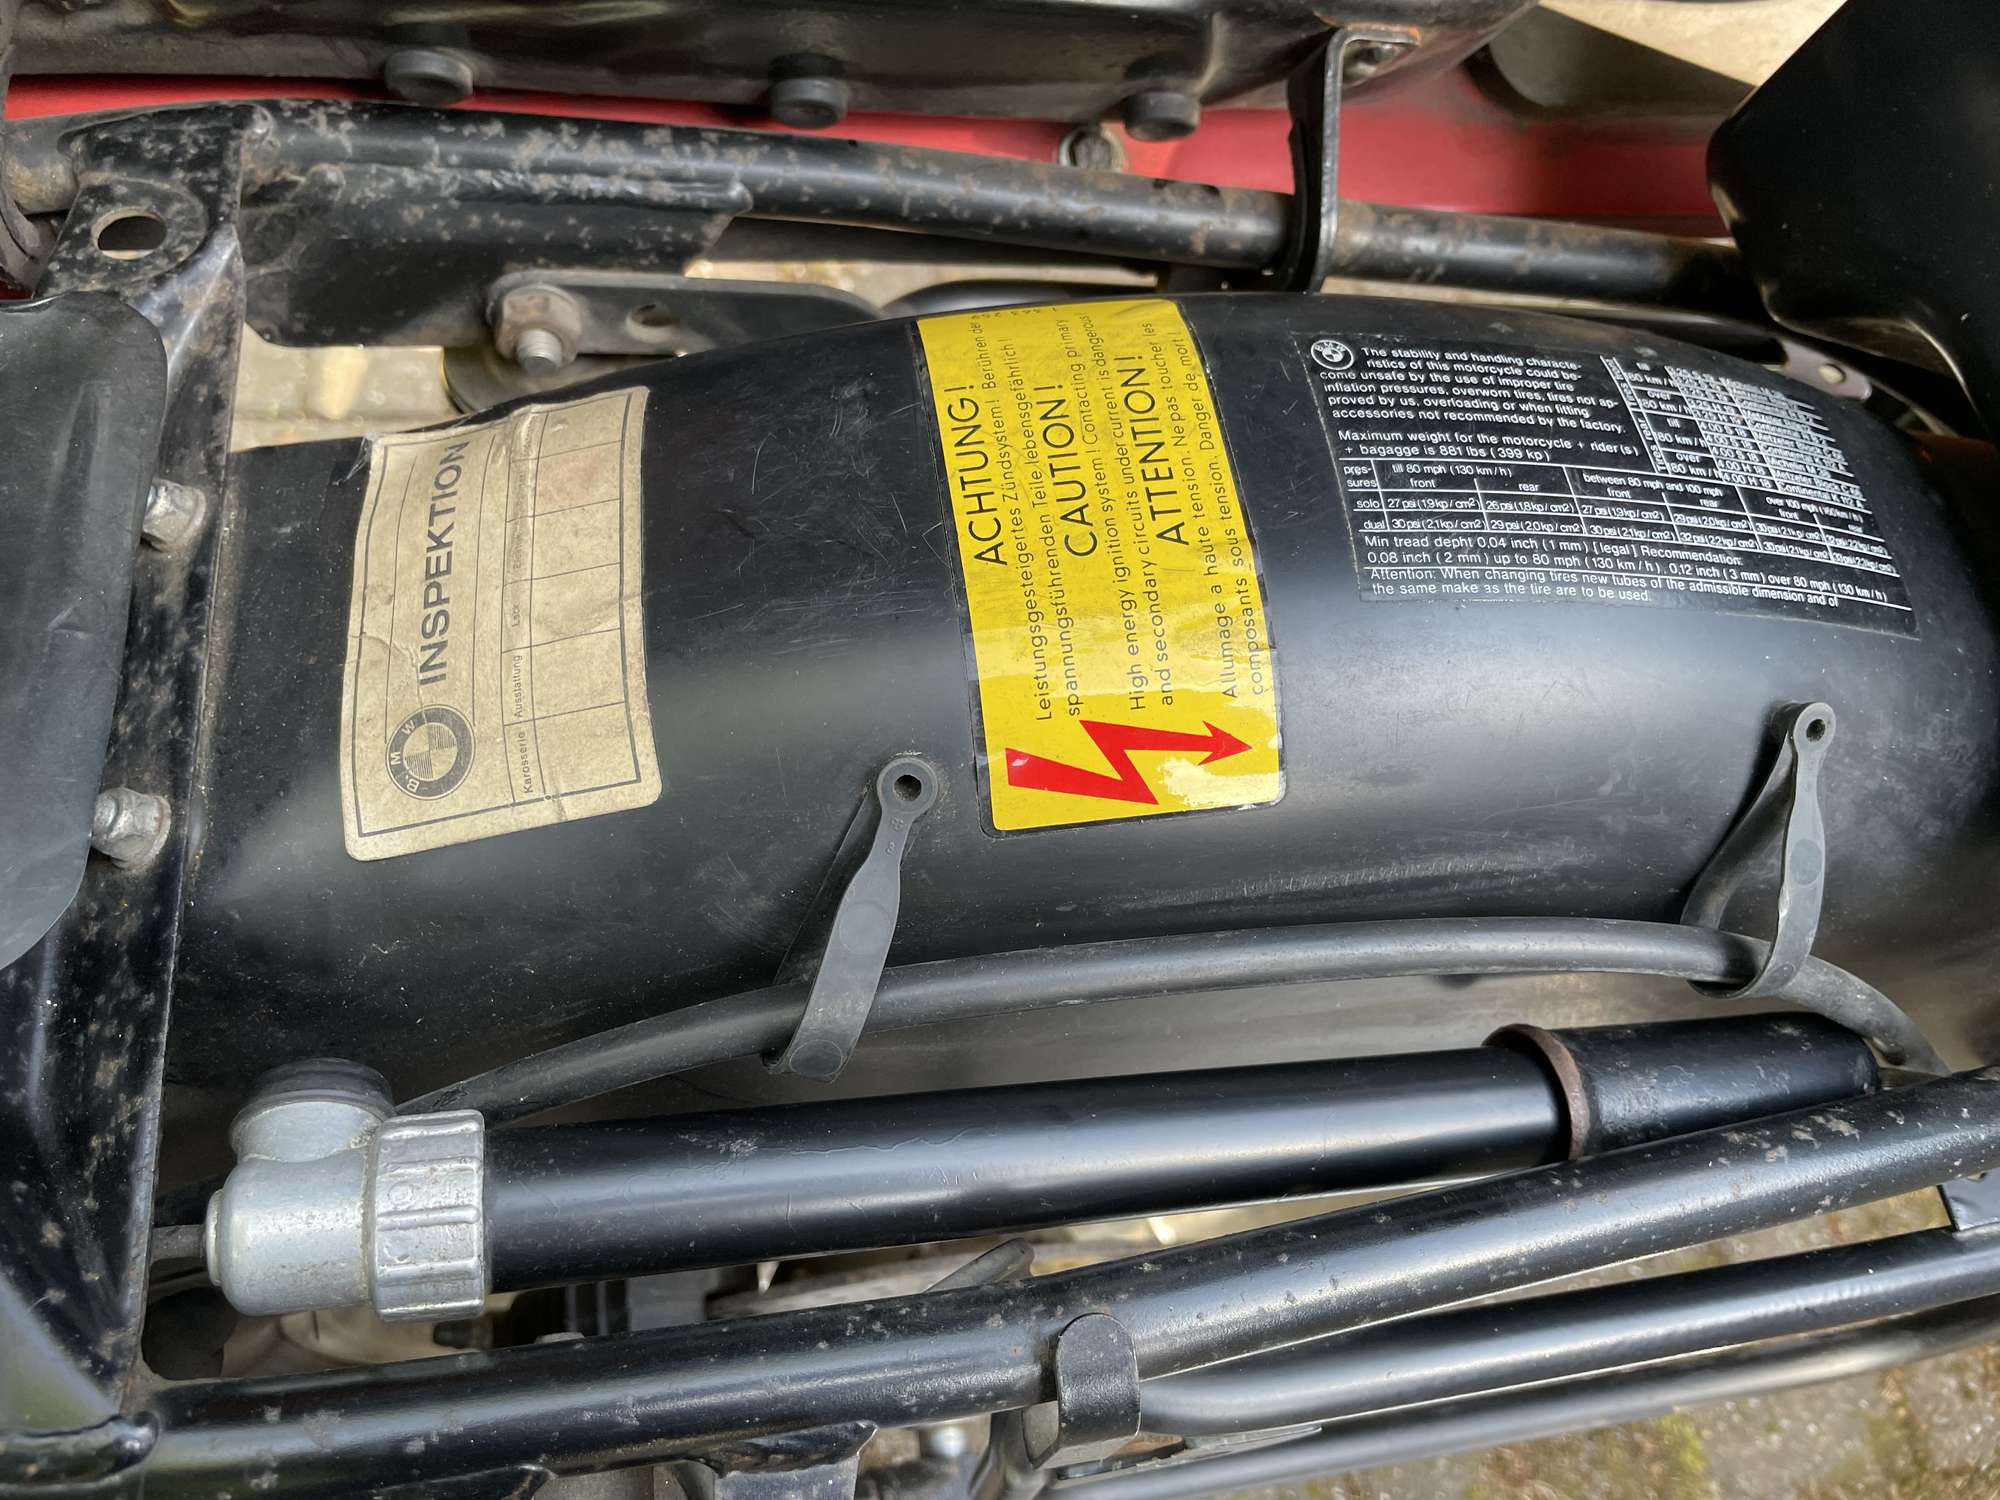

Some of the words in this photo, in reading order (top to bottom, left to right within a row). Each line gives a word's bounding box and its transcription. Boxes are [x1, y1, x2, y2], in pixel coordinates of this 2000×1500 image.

[968, 322, 981, 334] der
[1056, 319, 1079, 357] primary
[1141, 322, 1156, 336] les
[973, 336, 997, 388] Berühren
[1097, 370, 1110, 380] is
[1148, 341, 1170, 388] toucher
[1361, 347, 1387, 357] The
[1391, 348, 1439, 360] stability
[1444, 351, 1468, 361] and
[1470, 353, 1523, 366] handling
[1526, 358, 1582, 370] characte-
[1367, 359, 1406, 369] ristics
[1409, 360, 1422, 369] of
[1426, 361, 1450, 371] this
[1453, 363, 1522, 376] motorcycle
[1526, 369, 1559, 379] could
[1561, 370, 1582, 381] be-
[1183, 373, 1198, 390] de
[1320, 371, 1356, 380] come
[1360, 371, 1405, 381] unsafe
[1408, 372, 1425, 384] by
[1429, 373, 1451, 383] the
[1454, 375, 1479, 384] use
[1482, 375, 1495, 385] of
[1498, 376, 1552, 390] improper
[1554, 381, 1575, 391] tire
[1323, 382, 1376, 393] inflation
[1380, 383, 1449, 396] pressures,
[1452, 387, 1511, 398] overworn
[1513, 390, 1546, 401] tires,
[1547, 391, 1574, 403] tires
[1576, 395, 1597, 406] not
[1599, 398, 1619, 409] ap-
[1647, 390, 1671, 401] over
[999, 338, 1040, 464] lebensgefährlich!
[1070, 363, 1097, 444] Contacting
[1167, 396, 1185, 421] pas
[1328, 395, 1375, 406] proved
[1378, 395, 1395, 407] by
[1400, 397, 1420, 407] us,
[1423, 398, 1499, 411] overloading
[1502, 402, 1516, 411] or
[1519, 402, 1553, 413] when
[1554, 403, 1590, 419] fitting
[1171, 425, 1188, 446] Ne
[1191, 397, 1214, 449] Danger
[1332, 408, 1415, 419] accessories
[1418, 410, 1440, 420] not
[1443, 411, 1535, 425] recommended
[1537, 415, 1554, 427] by
[1557, 416, 1578, 428] the
[1580, 419, 1626, 434] factory.
[1338, 430, 1403, 441] Maximum
[1407, 432, 1452, 444] weight
[1454, 432, 1473, 443] for
[1477, 433, 1499, 444] the
[1501, 435, 1573, 449] motorcycle
[987, 399, 1018, 501] Zündsystem!
[1114, 355, 1189, 545] ATTENTION!
[1360, 444, 1419, 457] bagagge
[1423, 445, 1436, 455] is
[1440, 445, 1462, 456] 881
[1466, 446, 1487, 457] lbs
[1676, 453, 1701, 463] over
[944, 384, 1007, 565] ACHTUNG!
[1033, 384, 1097, 556] CAUTION!
[1181, 450, 1204, 519] tension.
[1209, 456, 1231, 519] tension.
[1343, 465, 1372, 475] pres-
[1347, 479, 1378, 488] sures
[1392, 463, 1404, 473] till
[1406, 464, 1421, 474] 80
[1423, 465, 1447, 475] mph
[1410, 478, 1436, 488] front
[1518, 483, 1539, 492] rear
[1583, 473, 1627, 486] between
[1627, 476, 1641, 487] 80
[1643, 480, 1664, 493] mph
[1666, 482, 1684, 492] and
[1686, 484, 1700, 494] 100
[1703, 486, 1723, 497] mph
[1029, 471, 1049, 507] Teile
[1356, 498, 1380, 509] solo
[1607, 487, 1632, 499] front
[1700, 498, 1718, 508] rear
[1125, 491, 1149, 554] circuits
[1364, 520, 1385, 529] dual
[418, 439, 469, 685] INSPEKTION
[1105, 518, 1130, 583] ignition
[1196, 526, 1218, 576] haute
[1224, 528, 1243, 566] sous
[1364, 535, 1389, 547] Min
[1393, 536, 1429, 548] tread
[1434, 536, 1474, 549] depht
[1510, 537, 1539, 549] inch
[1640, 545, 1744, 566] Recommendation:
[1371, 568, 1437, 580] Attention:
[1440, 568, 1480, 580] When
[1484, 568, 1546, 583] changing
[1549, 570, 1578, 582] tires
[1582, 573, 1607, 584] new
[1612, 574, 1647, 588] tubes
[1650, 577, 1662, 588] of
[1666, 578, 1685, 591] the
[1689, 580, 1749, 597] admissible
[1752, 585, 1805, 601] dimension
[1807, 592, 1827, 604] and
[1829, 595, 1840, 607] of
[1402, 552, 1431, 563] inch
[1493, 554, 1511, 566] up
[1514, 553, 1528, 564] to
[1532, 553, 1550, 565] 80
[1553, 555, 1581, 568] mph
[1695, 565, 1721, 578] inch
[1768, 574, 1792, 586] over
[1793, 576, 1808, 587] 80
[1809, 579, 1831, 592] mph
[1141, 560, 1168, 660] secondary
[1372, 583, 1395, 595] the
[1399, 585, 1438, 595] same
[1441, 582, 1480, 594] make
[1484, 584, 1500, 594] as
[1504, 582, 1526, 594] the
[1530, 583, 1552, 596] tire
[1555, 586, 1577, 596] are
[1581, 585, 1595, 597] to
[1598, 586, 1615, 599] be
[1618, 588, 1651, 601] used.
[1010, 507, 1052, 719] Leistungsgesteigertes
[1037, 514, 1083, 715] spannungsführenden
[1117, 589, 1137, 655] energy
[1213, 602, 1238, 697] Allumage
[1235, 578, 1265, 695] composants
[511, 655, 523, 718] Ausstattung
[1126, 664, 1147, 709] High
[1157, 668, 1173, 705] and
[389, 718, 420, 793] BMW
[518, 731, 533, 793] Karosserie
